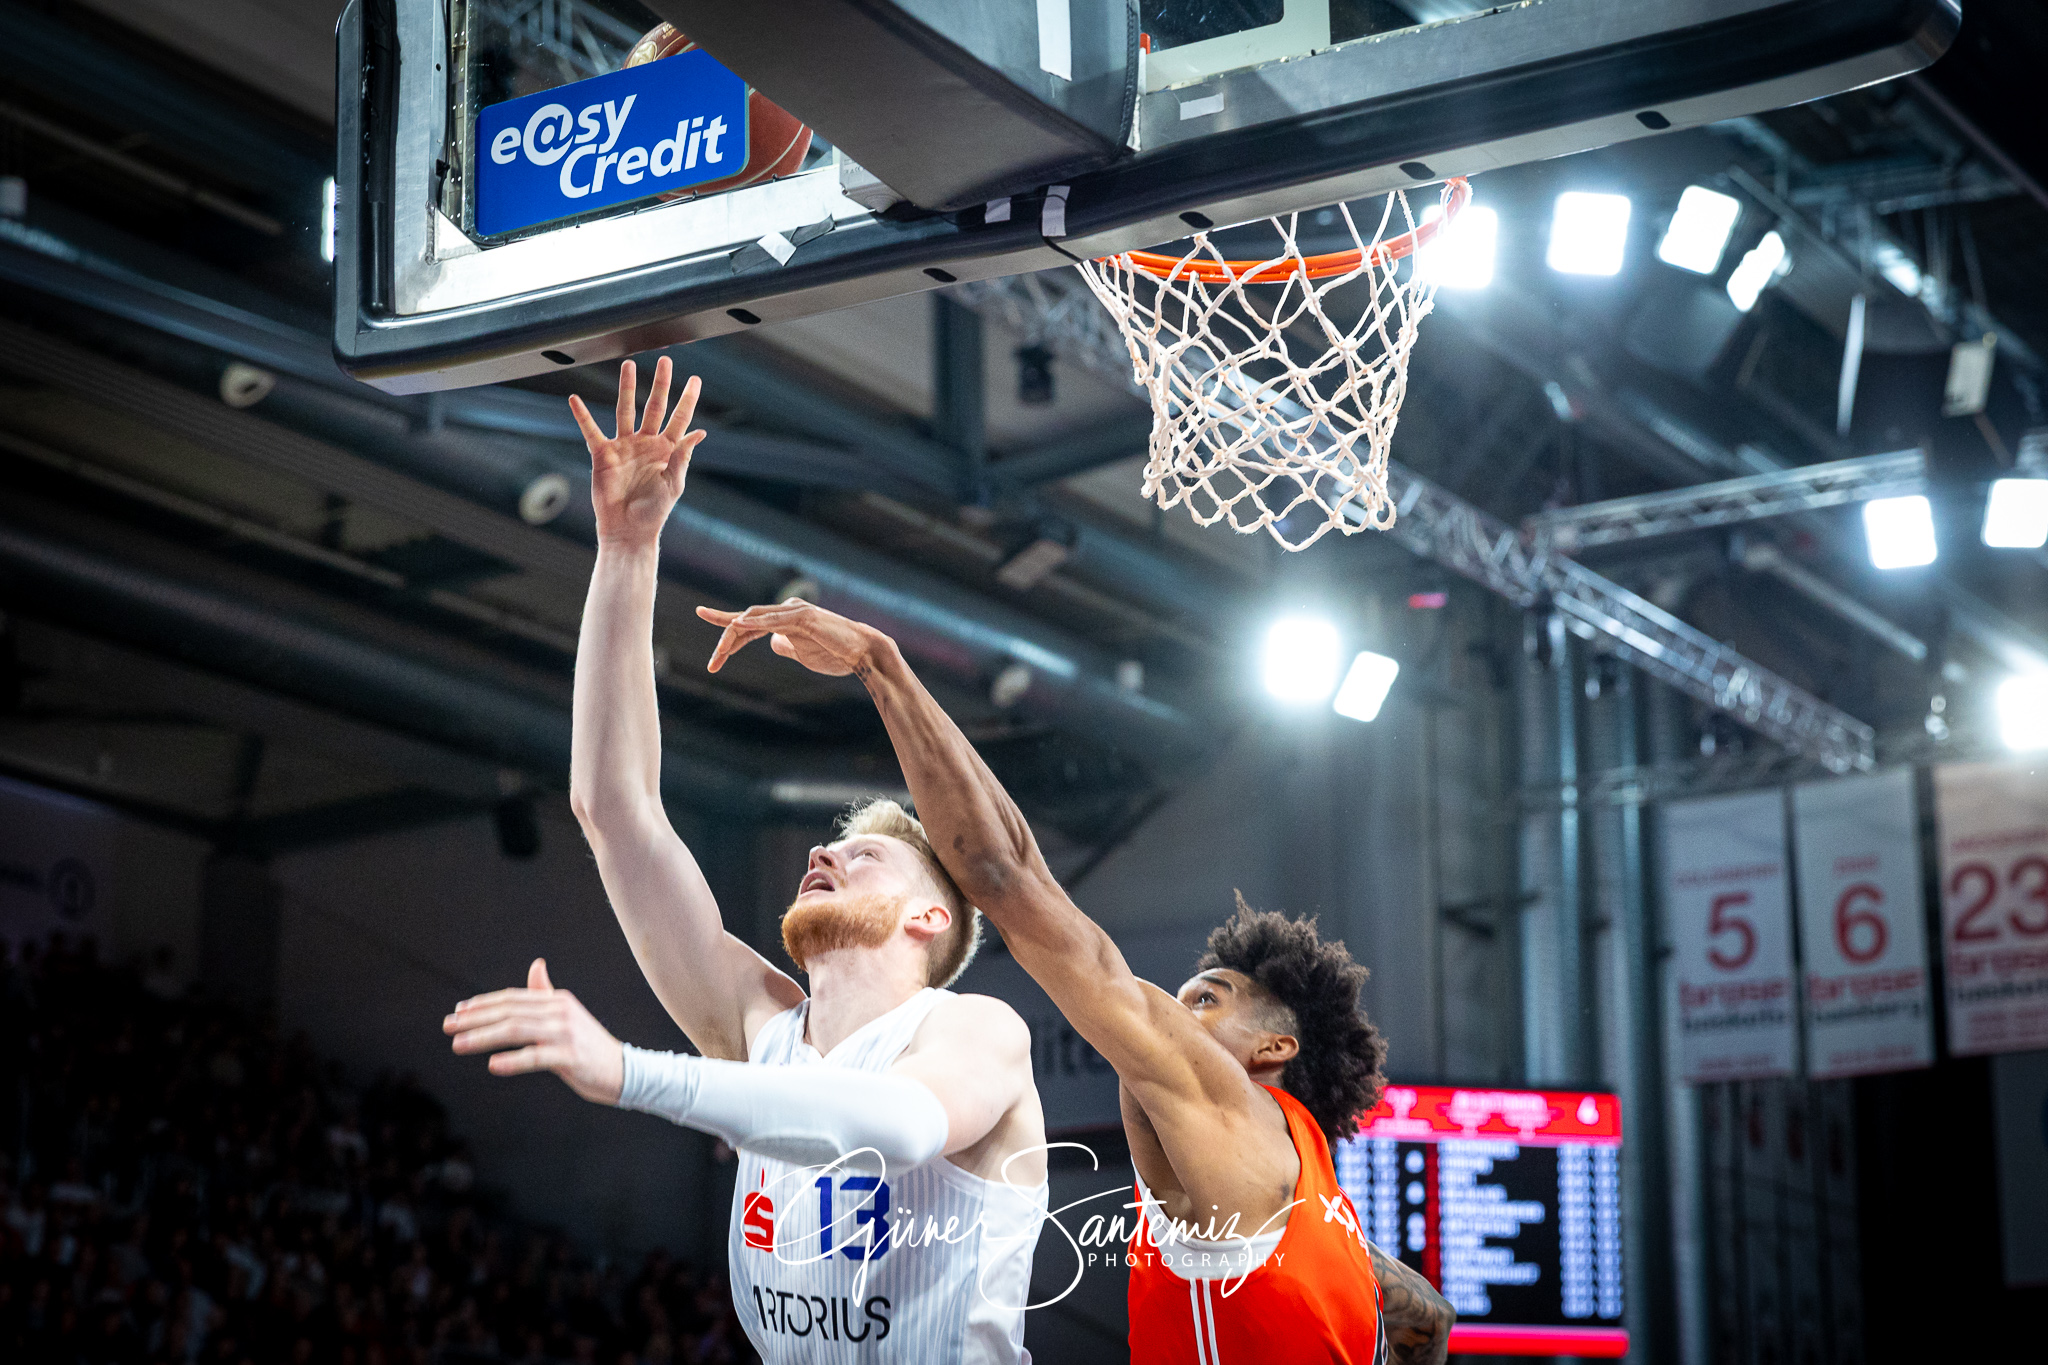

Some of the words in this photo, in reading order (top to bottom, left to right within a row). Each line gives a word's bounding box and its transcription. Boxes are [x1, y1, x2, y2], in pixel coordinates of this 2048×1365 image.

[490, 93, 638, 166] e@sy
[559, 114, 728, 199] Credit
[1707, 890, 1758, 971] 5
[1833, 882, 1889, 965] 6
[1950, 854, 2048, 943] 23
[814, 1176, 890, 1261] 13
